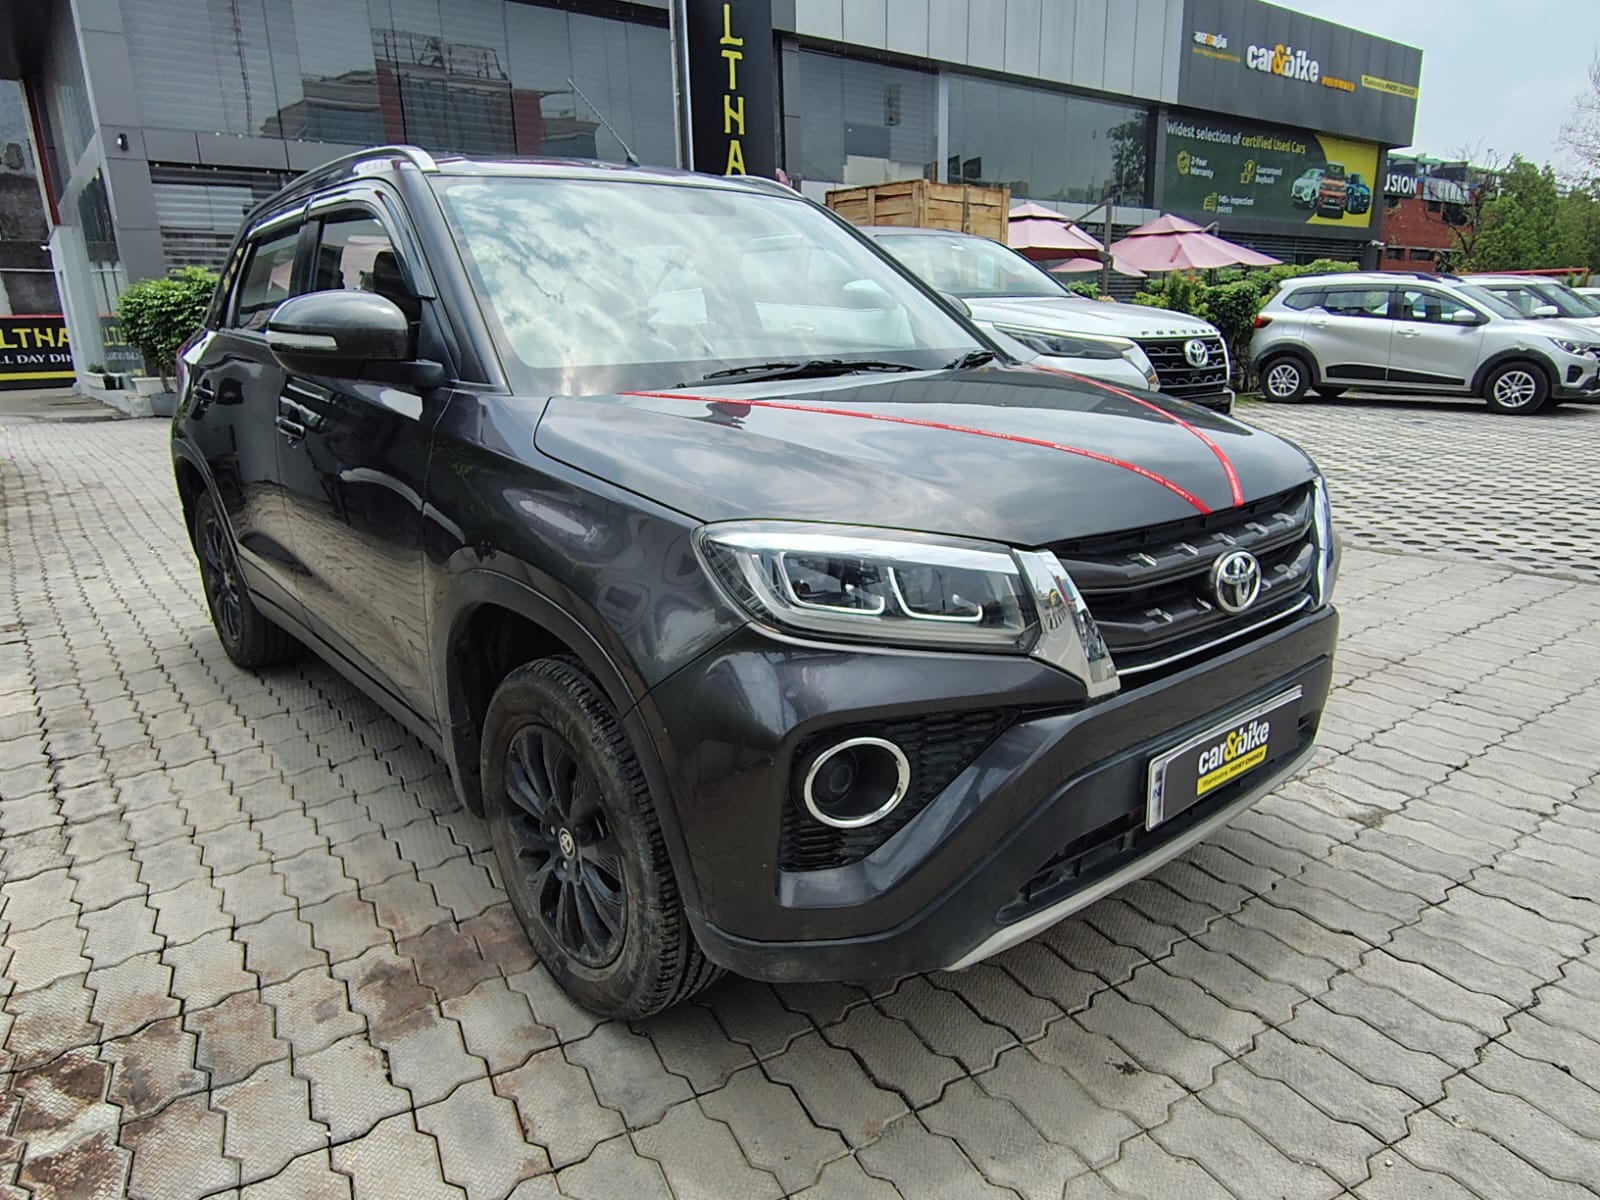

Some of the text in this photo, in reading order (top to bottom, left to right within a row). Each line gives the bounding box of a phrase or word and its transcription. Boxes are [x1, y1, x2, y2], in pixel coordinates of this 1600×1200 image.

[1246, 44, 1319, 83] car&bike
[1166, 121, 1306, 155] Widest selection of certified Used Cars
[16, 354, 45, 364] DAY
[1198, 720, 1270, 775] car&bike
